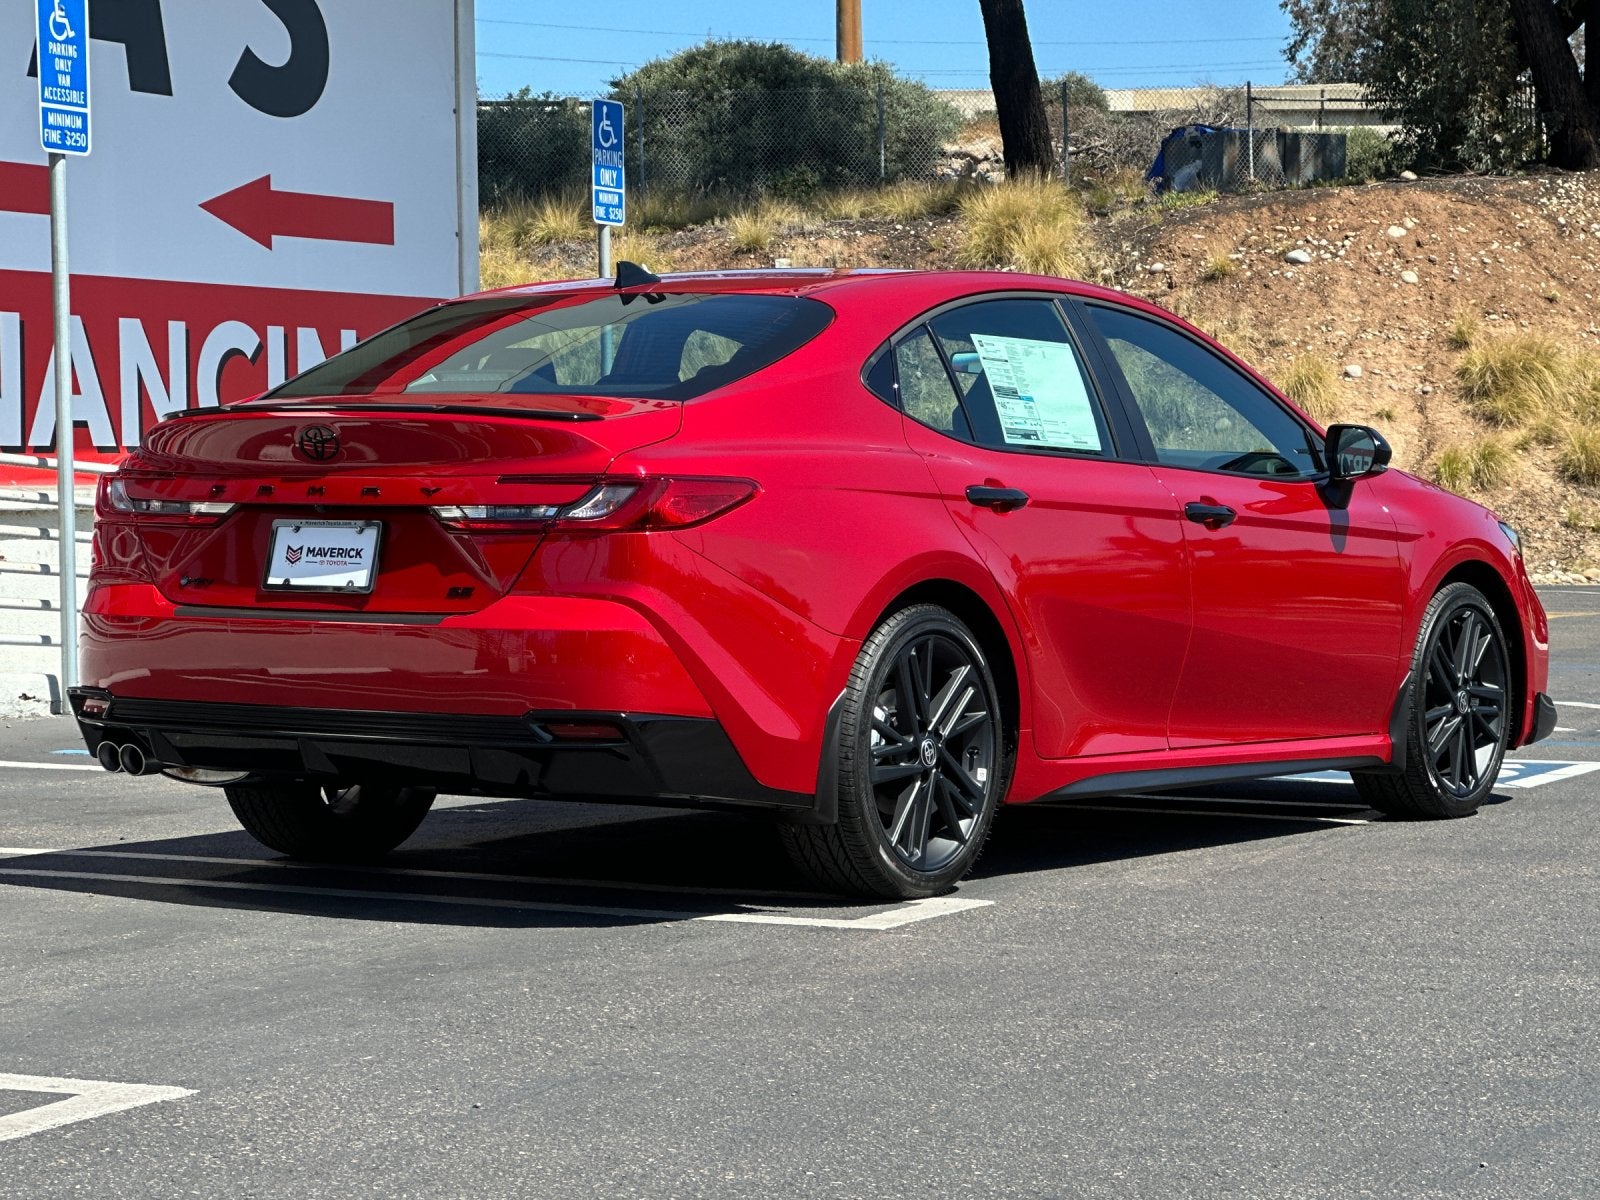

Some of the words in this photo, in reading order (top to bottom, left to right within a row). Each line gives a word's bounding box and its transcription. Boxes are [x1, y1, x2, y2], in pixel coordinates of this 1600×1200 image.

[48, 41, 78, 58] PARKING
[54, 58, 72, 73] ONLY
[57, 73, 71, 88] VAN
[43, 86, 85, 105] ACCESSIBLE
[47, 111, 83, 129] MINIMUM
[43, 128, 62, 144] FINE
[64, 129, 87, 147] $250
[594, 148, 622, 168] PARKING
[600, 168, 618, 187] ONLY
[598, 191, 619, 206] MINIMUM
[595, 205, 607, 219] FINE
[306, 546, 364, 559] MAVERICK
